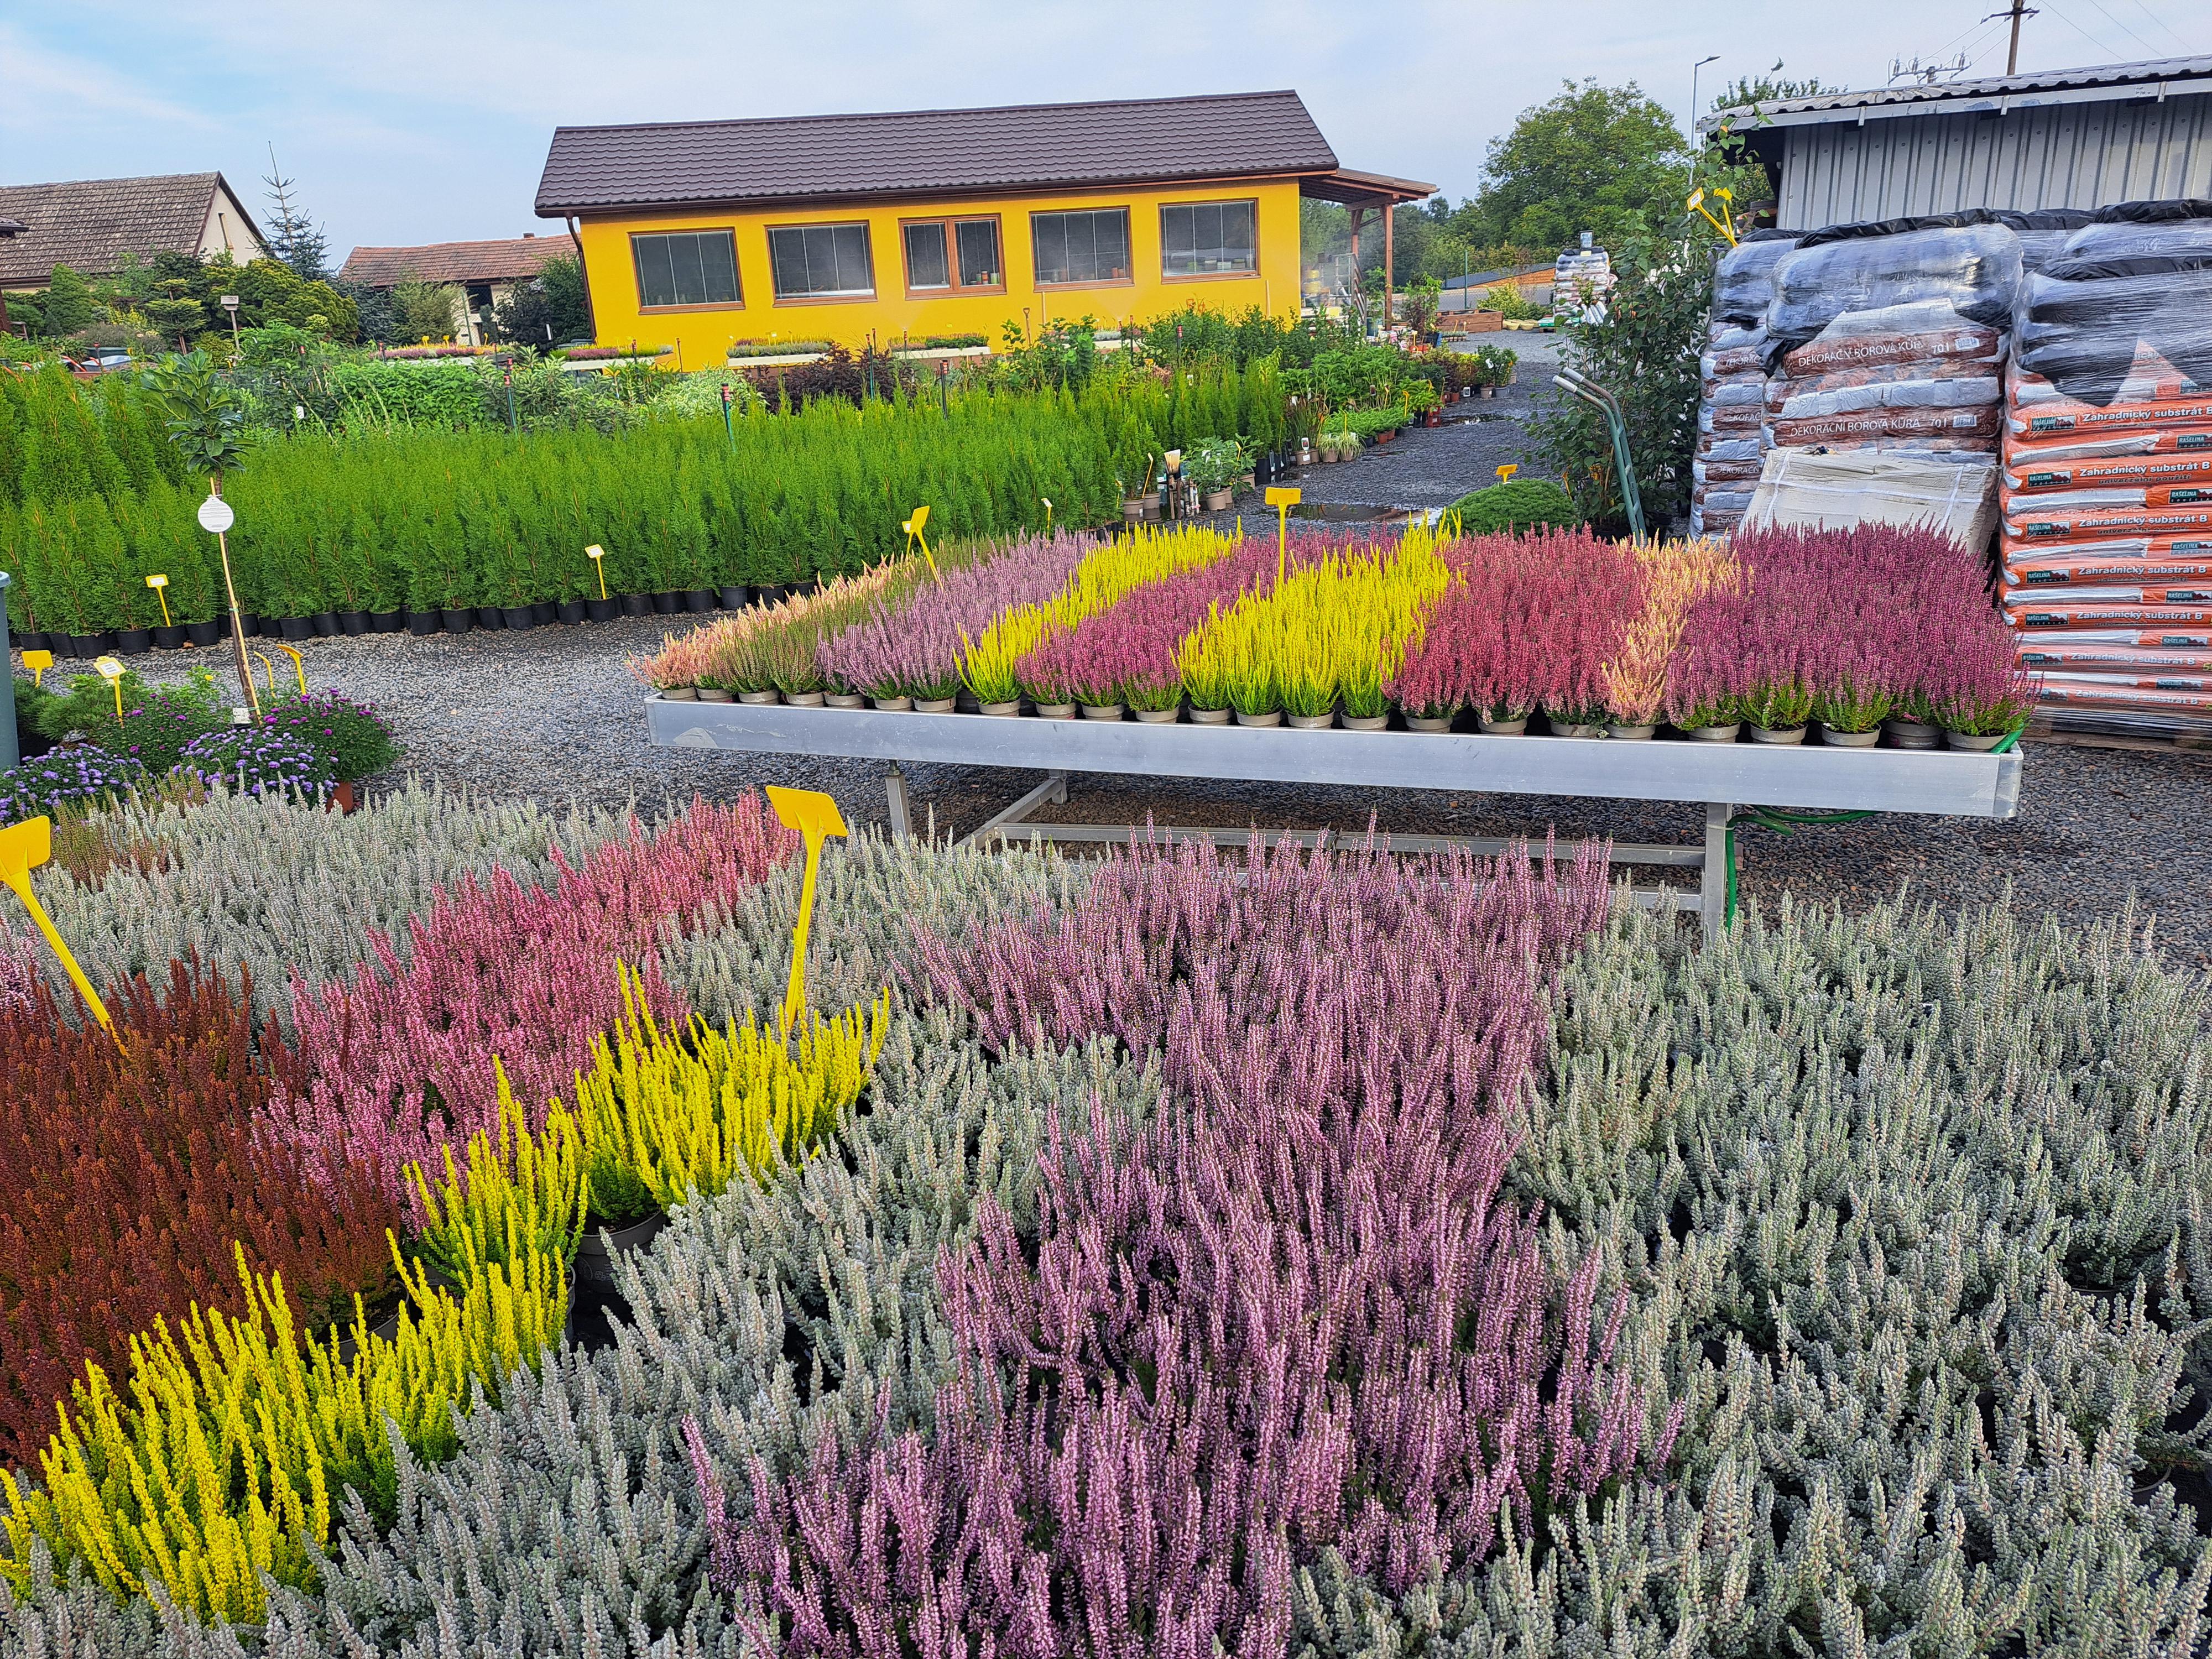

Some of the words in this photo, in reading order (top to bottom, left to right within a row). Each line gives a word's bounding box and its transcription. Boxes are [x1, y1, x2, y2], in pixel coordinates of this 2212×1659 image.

[1854, 342, 1896, 357] BOROVÁ
[2083, 409, 2152, 422] Zahradnický
[2154, 406, 2203, 418] substrát
[1848, 418, 1888, 432] BOROVÁ
[2079, 463, 2147, 477] Zahradnický
[2150, 461, 2199, 473] substrát
[2201, 461, 2211, 470] B
[2078, 516, 2146, 528] Zahradnický
[2148, 515, 2196, 524] substrát
[2199, 514, 2208, 523] B
[2078, 567, 2146, 576] Zahradnický
[2147, 566, 2195, 575] substrát
[2198, 565, 2208, 574] B
[2076, 611, 2143, 620] Zahradnický
[2145, 611, 2192, 620] substrát
[2194, 611, 2203, 620] B
[2070, 653, 2136, 664] Zahradnický
[2138, 655, 2184, 665] substrát
